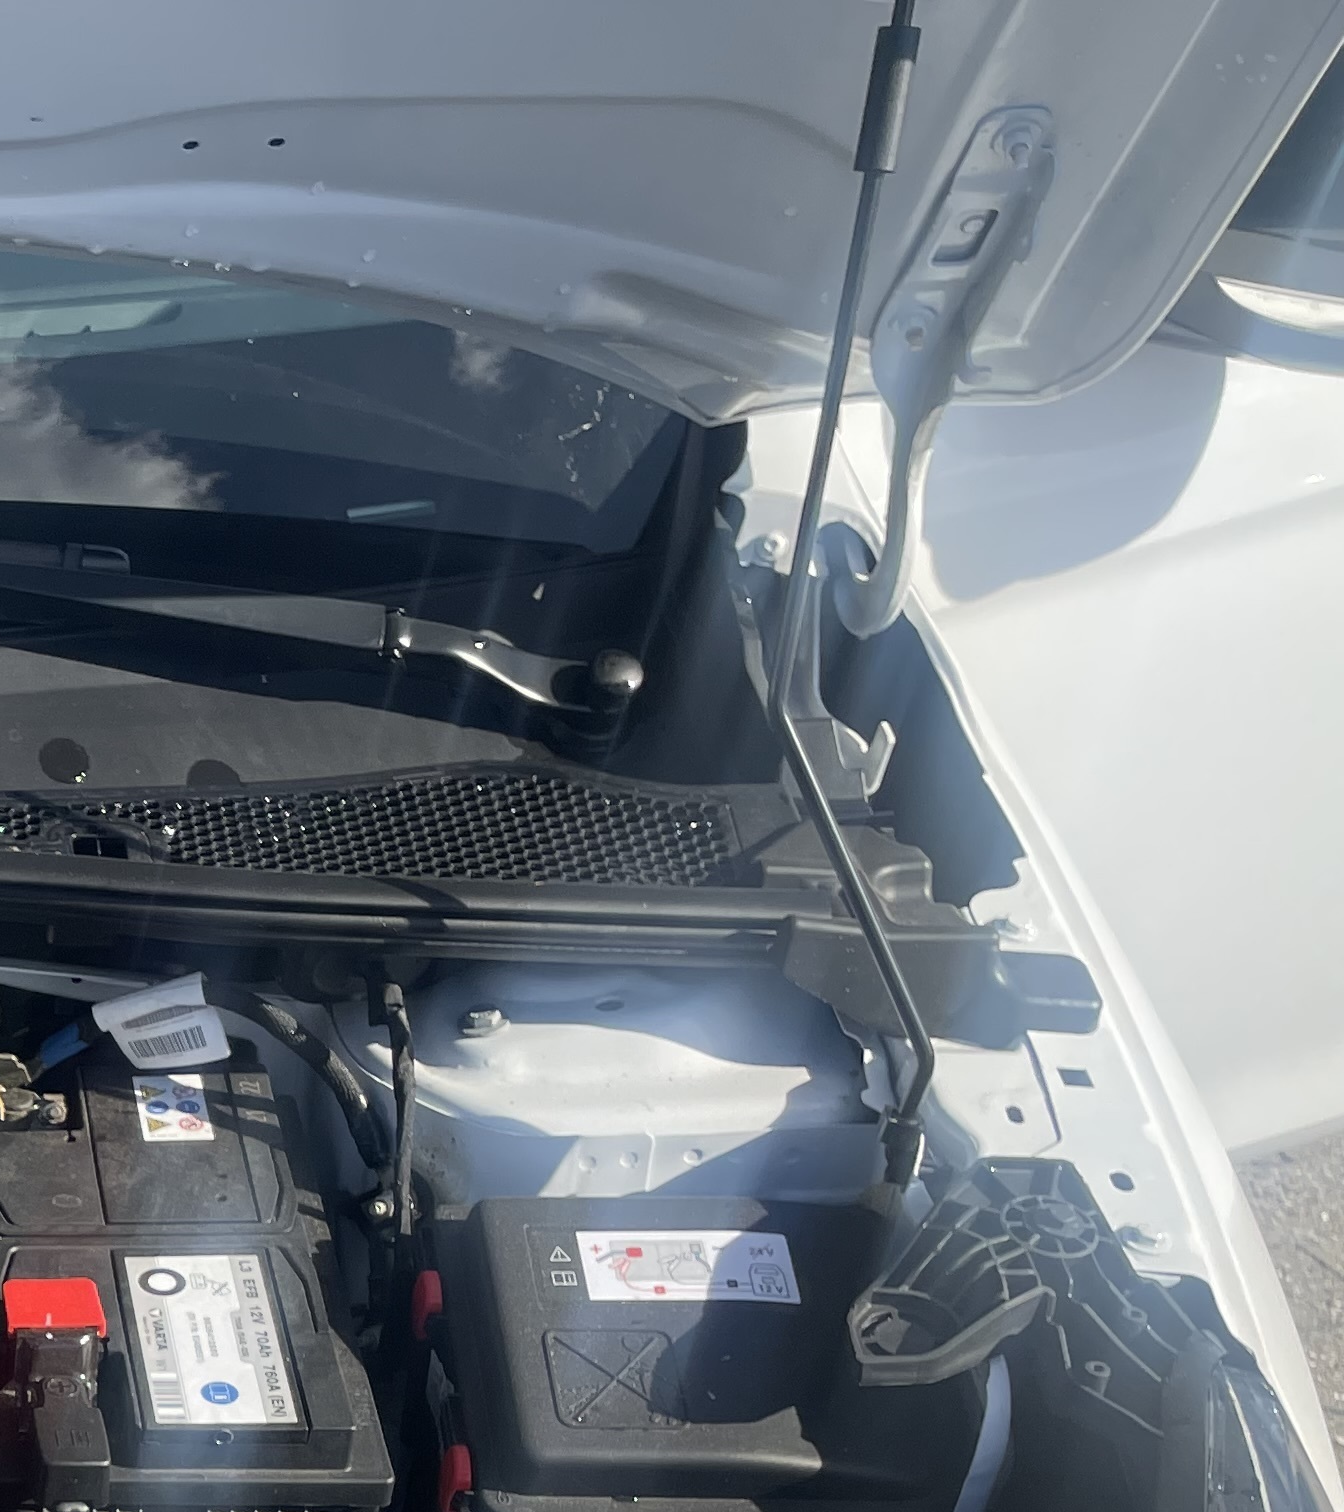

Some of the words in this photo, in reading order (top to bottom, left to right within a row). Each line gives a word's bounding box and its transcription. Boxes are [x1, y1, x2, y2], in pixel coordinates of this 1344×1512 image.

[249, 1305, 265, 1324] 12V
[151, 1317, 168, 1351] VARTA
[255, 1331, 272, 1358] 70Ah
[262, 1363, 280, 1392] 760A
